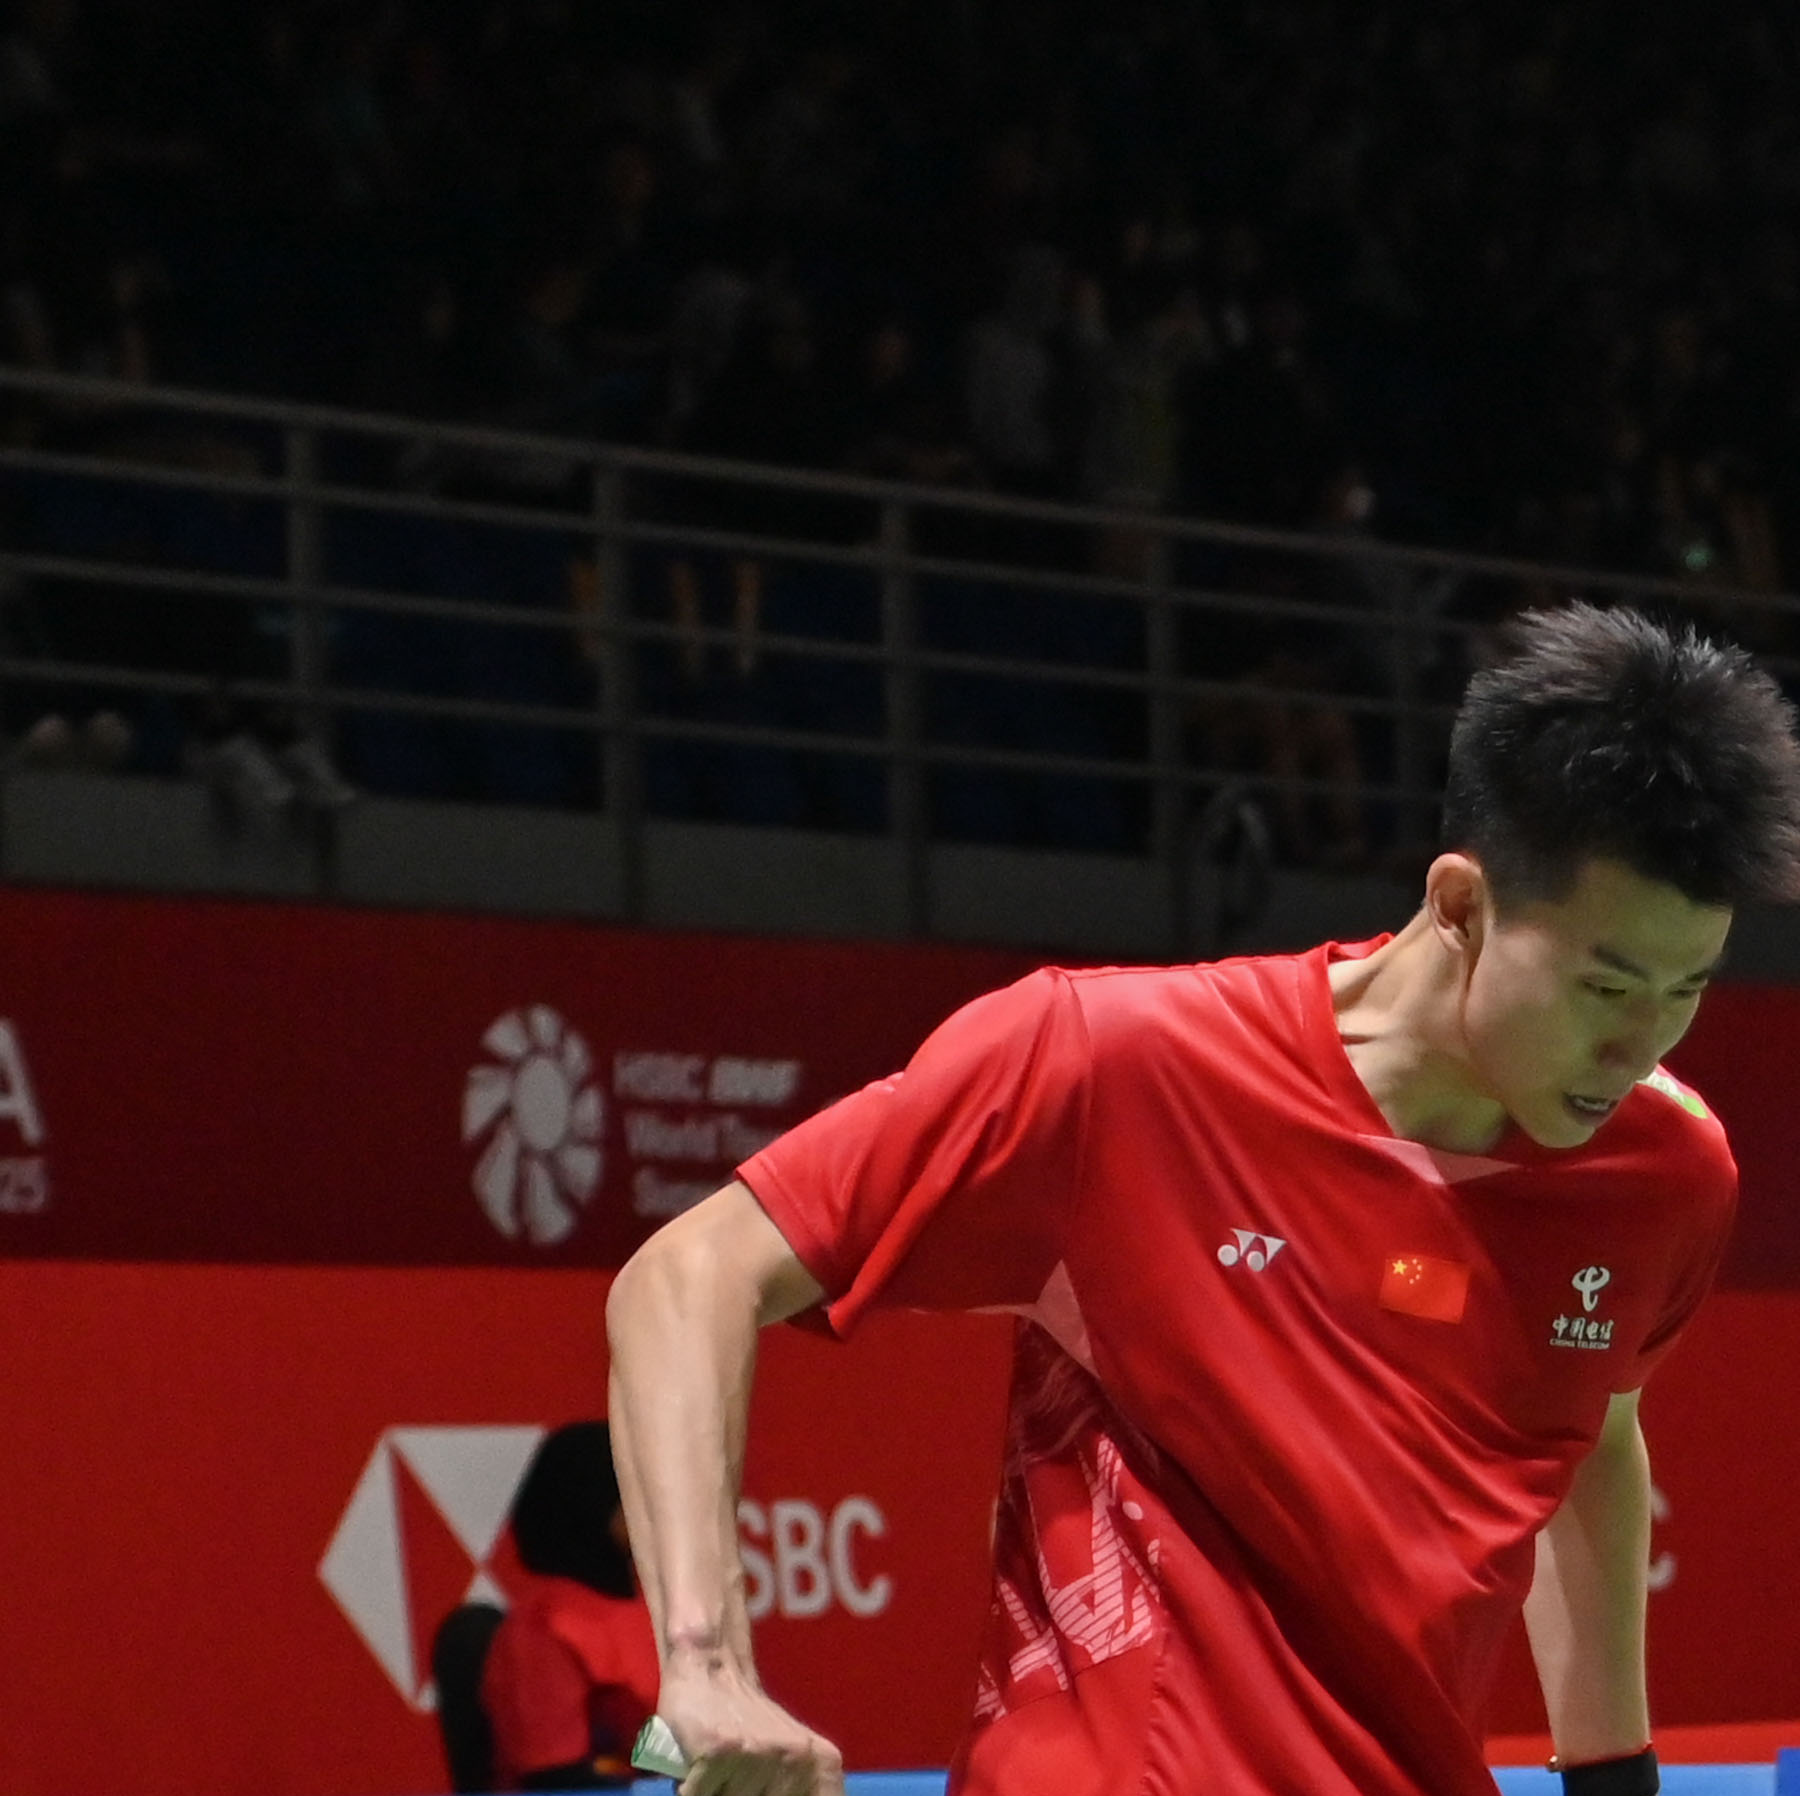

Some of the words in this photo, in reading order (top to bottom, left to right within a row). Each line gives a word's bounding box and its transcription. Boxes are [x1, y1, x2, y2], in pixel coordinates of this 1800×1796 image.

[1552, 1314, 1614, 1340] 中国电信
[737, 1497, 892, 1618] SBC
